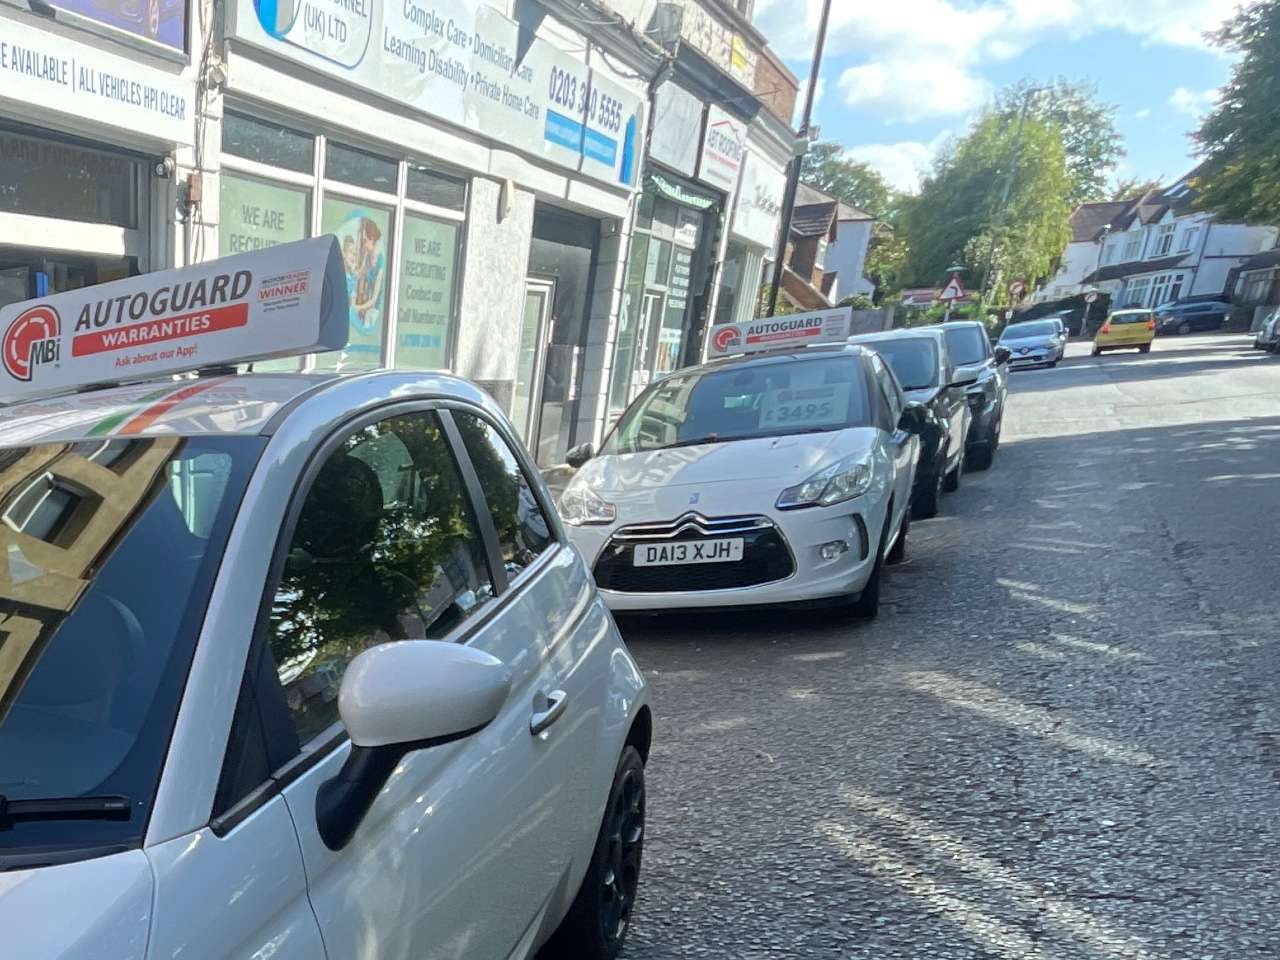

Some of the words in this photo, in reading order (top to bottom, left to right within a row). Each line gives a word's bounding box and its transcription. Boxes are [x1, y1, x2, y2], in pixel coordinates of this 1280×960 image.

[304, 3, 325, 40] (UK)
[329, 15, 348, 43] LTD
[403, 0, 446, 39] Complex
[447, 18, 467, 48] Care
[11, 46, 68, 85] AVAILABLE
[79, 67, 96, 94] ALL
[99, 71, 141, 106] VEHICLES
[144, 85, 158, 109] HPI
[160, 92, 186, 120] CLEAR
[384, 26, 427, 74] Learning
[428, 48, 470, 92] Disability
[475, 71, 501, 102] Private
[502, 84, 523, 112] Home
[524, 95, 540, 120] Care
[549, 65, 577, 110] 0203
[578, 81, 597, 120] 30
[598, 93, 622, 133] 5555
[241, 204, 261, 227] WE
[262, 209, 285, 231] ARE
[230, 233, 280, 253] RECR
[74, 270, 253, 332] AUTOGUARD
[260, 281, 305, 299] WINNER
[102, 314, 210, 348] WARRANTIES
[747, 317, 822, 336] AUTOGUARD
[31, 338, 61, 366] MBi
[133, 352, 157, 365] about
[646, 545, 688, 563] DA13
[693, 541, 732, 560] XJH
